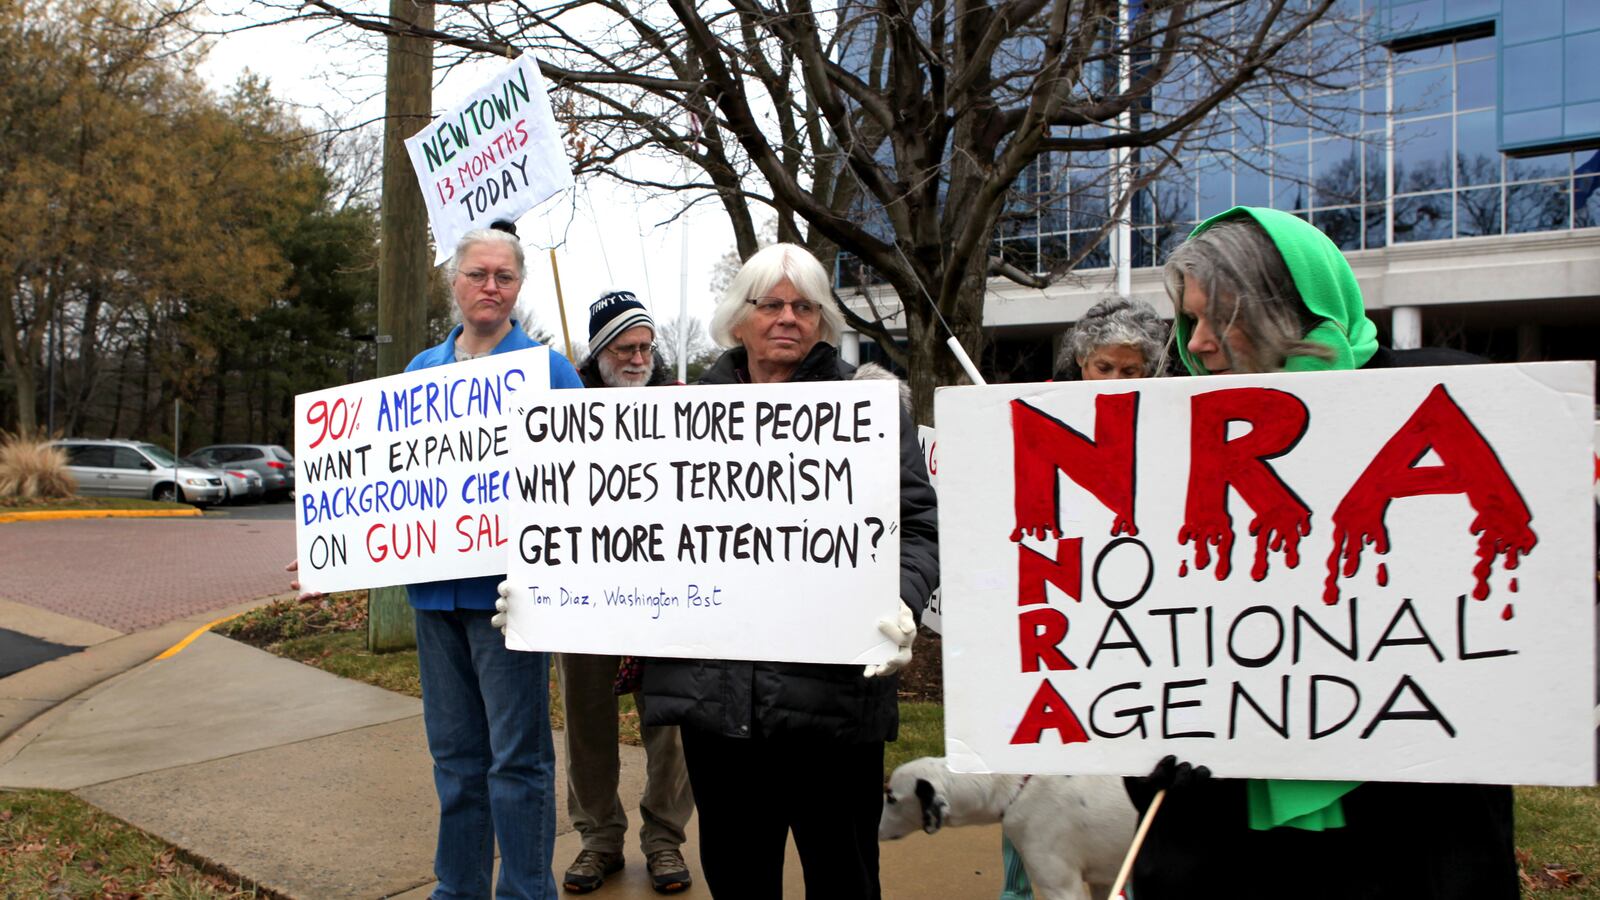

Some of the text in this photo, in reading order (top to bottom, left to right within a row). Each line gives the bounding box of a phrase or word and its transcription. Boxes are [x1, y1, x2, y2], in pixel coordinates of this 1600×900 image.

[422, 67, 530, 173] NEWTOWN
[436, 119, 529, 206] 13 MONTHS
[460, 154, 529, 221] TODAY
[306, 397, 363, 449] 90%
[675, 401, 745, 443] MORE
[755, 400, 885, 447] PEOPLE.
[304, 444, 372, 484] WANT
[515, 451, 853, 507] WHY DOES TERRORISM
[302, 477, 448, 526] BACKGROUND
[1010, 383, 1539, 606] NRA
[309, 534, 347, 570] ON
[366, 520, 436, 563] GUN
[519, 524, 582, 566] GET
[591, 523, 665, 564] MORE
[1018, 536, 1155, 609] NO
[528, 584, 723, 620] Tom Diaz, Washington Post
[1018, 594, 1520, 674] RATIONAL
[1009, 674, 1458, 745] AGENDA
